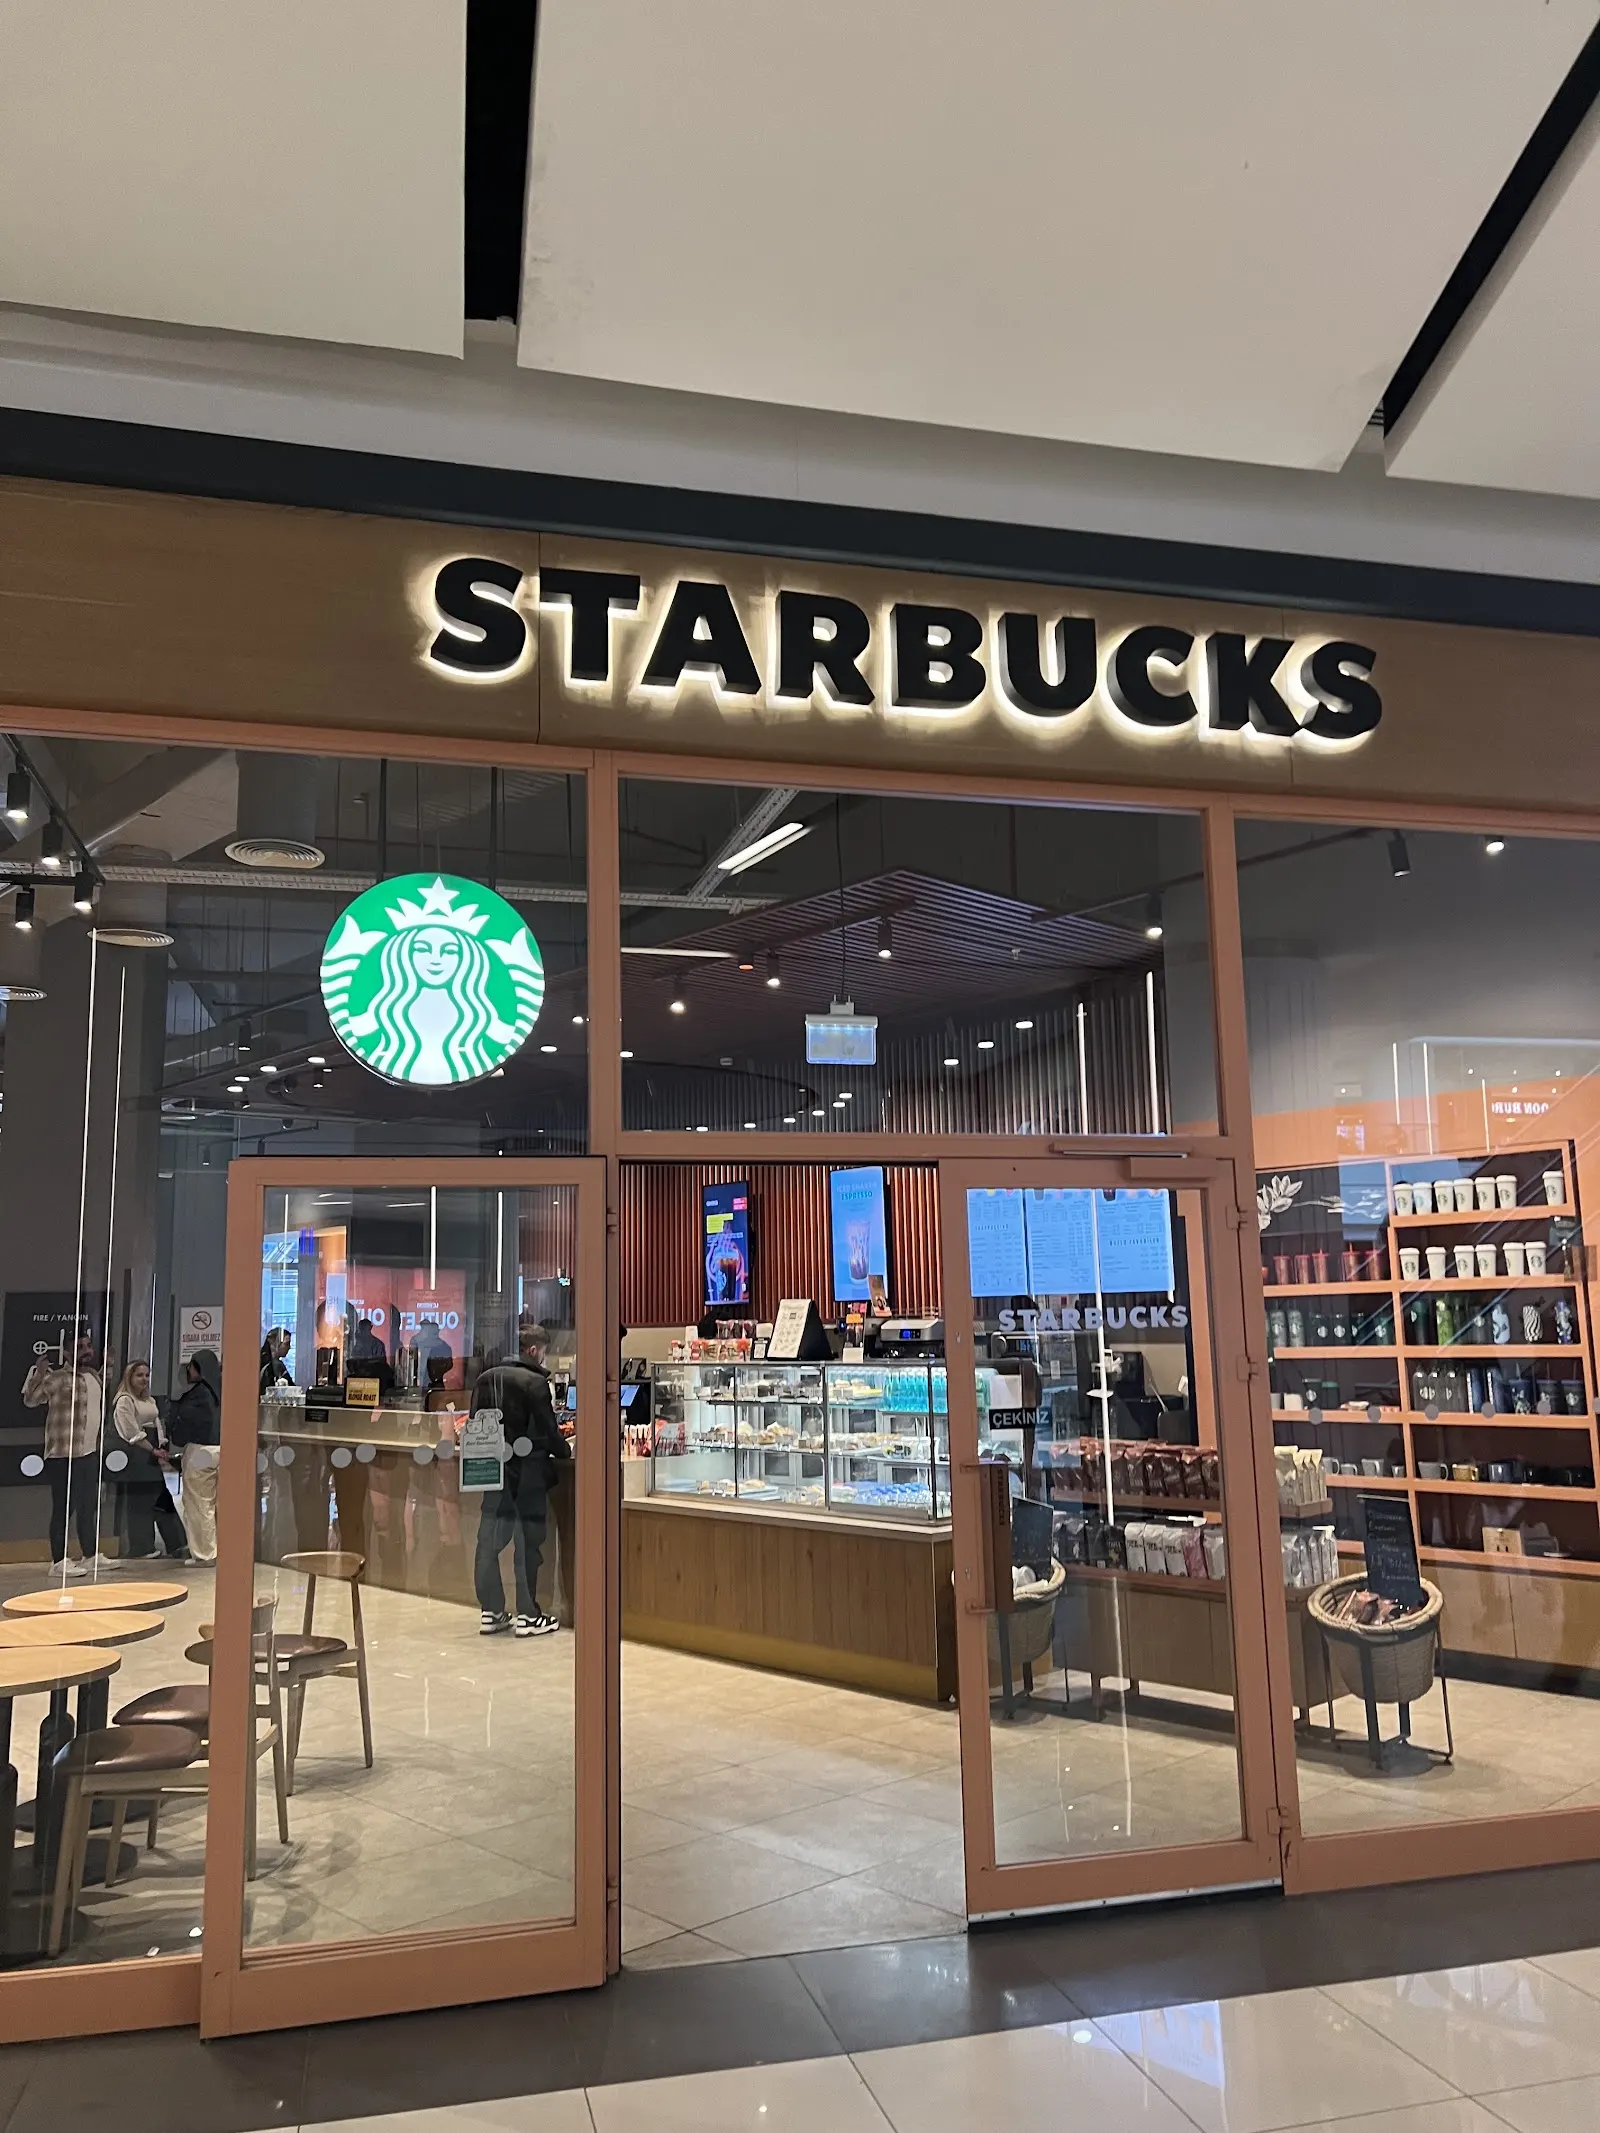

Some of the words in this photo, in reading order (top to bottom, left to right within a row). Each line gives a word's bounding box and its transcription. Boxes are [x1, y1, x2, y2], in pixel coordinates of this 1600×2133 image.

[428, 556, 1382, 739] STARBUCKS
[841, 1190, 873, 1201] ESPRESSO
[33, 1314, 49, 1322] FIRE
[998, 1305, 1189, 1332] STARBUCKS
[992, 1409, 1050, 1428] ÇEKİNİZ
